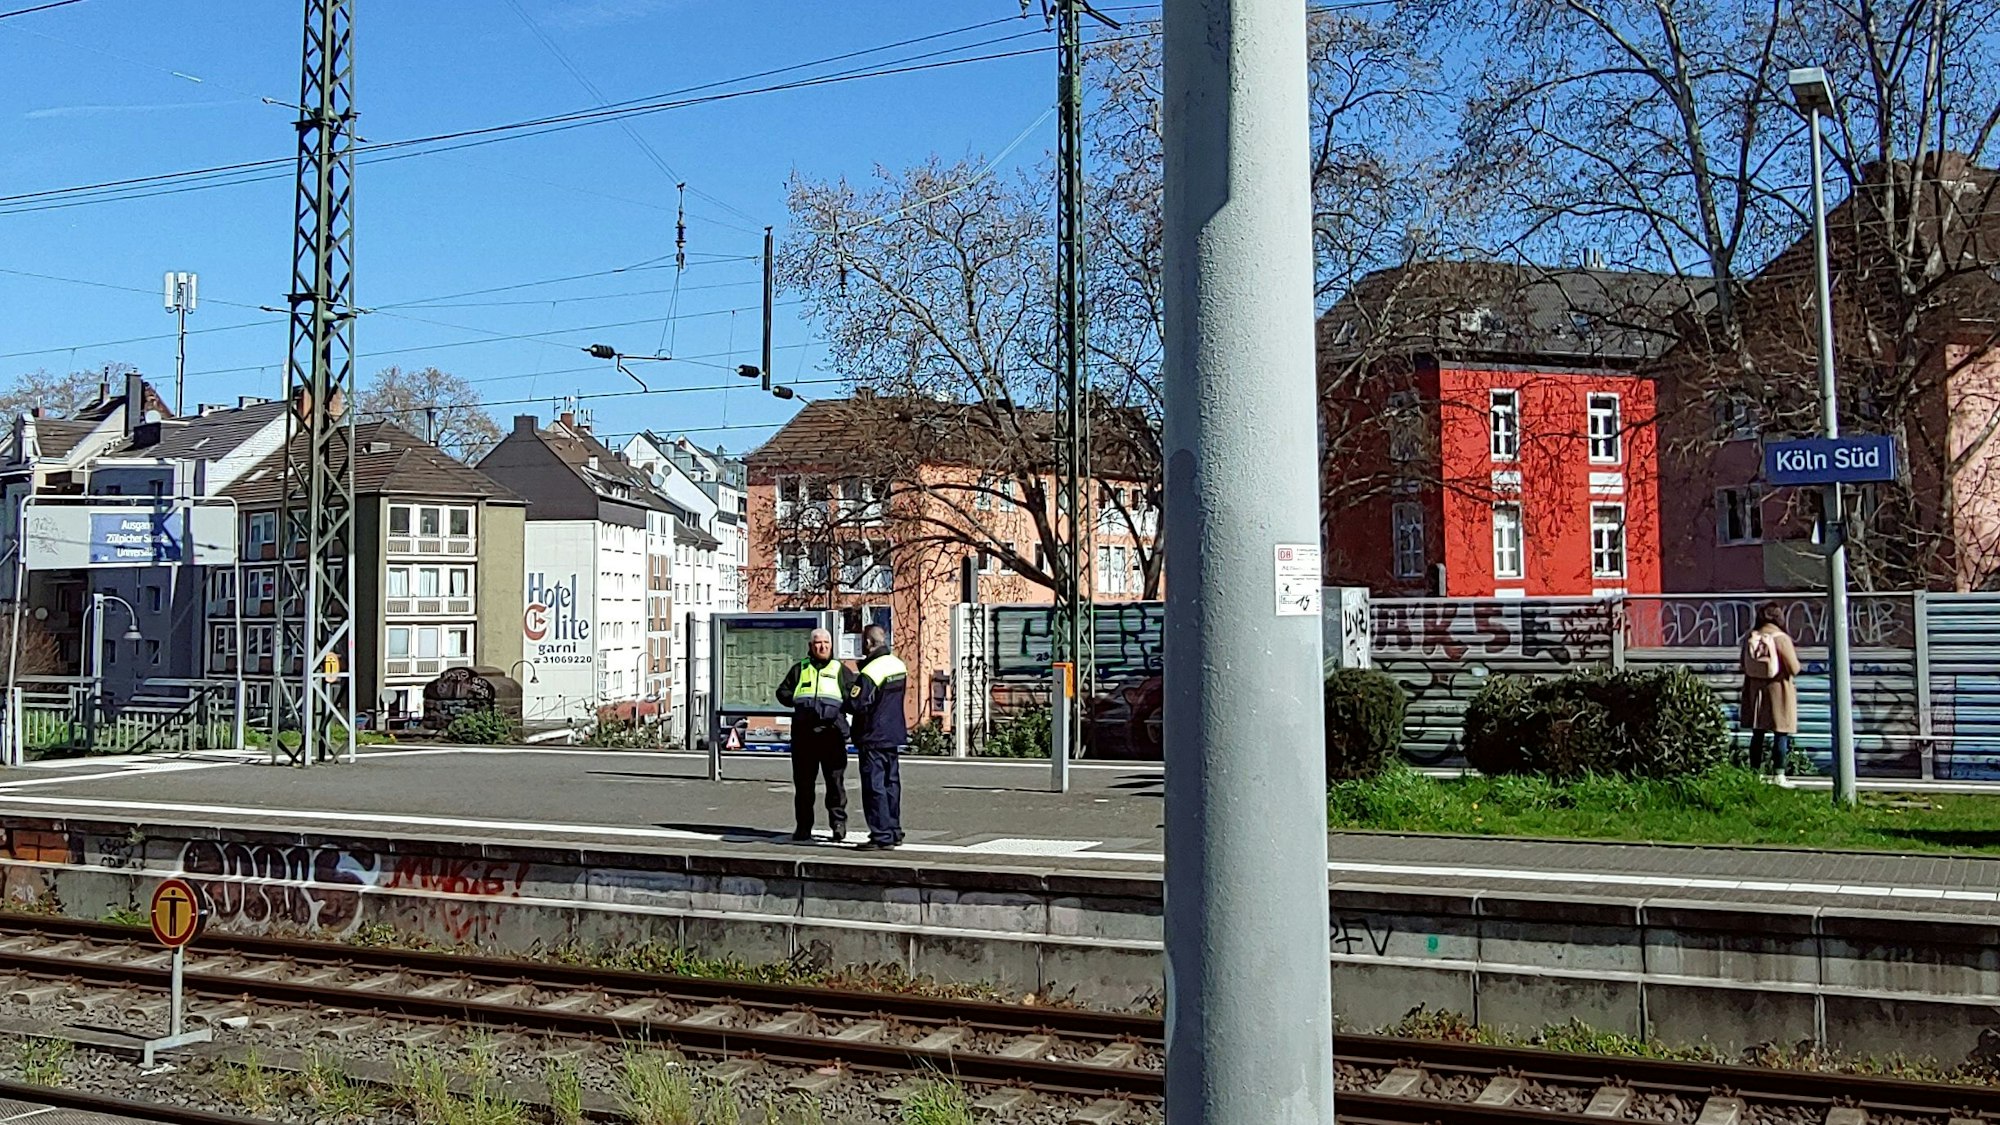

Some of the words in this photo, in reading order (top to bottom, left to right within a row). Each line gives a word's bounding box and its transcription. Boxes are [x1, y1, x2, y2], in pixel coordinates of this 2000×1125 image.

[1777, 450, 1827, 471] Köln
[1834, 447, 1879, 469] Süd
[1279, 550, 1292, 560] DB
[528, 573, 577, 608] Hotel
[524, 603, 589, 640] Elite
[538, 642, 576, 655] garni
[543, 655, 592, 664] 31069220
